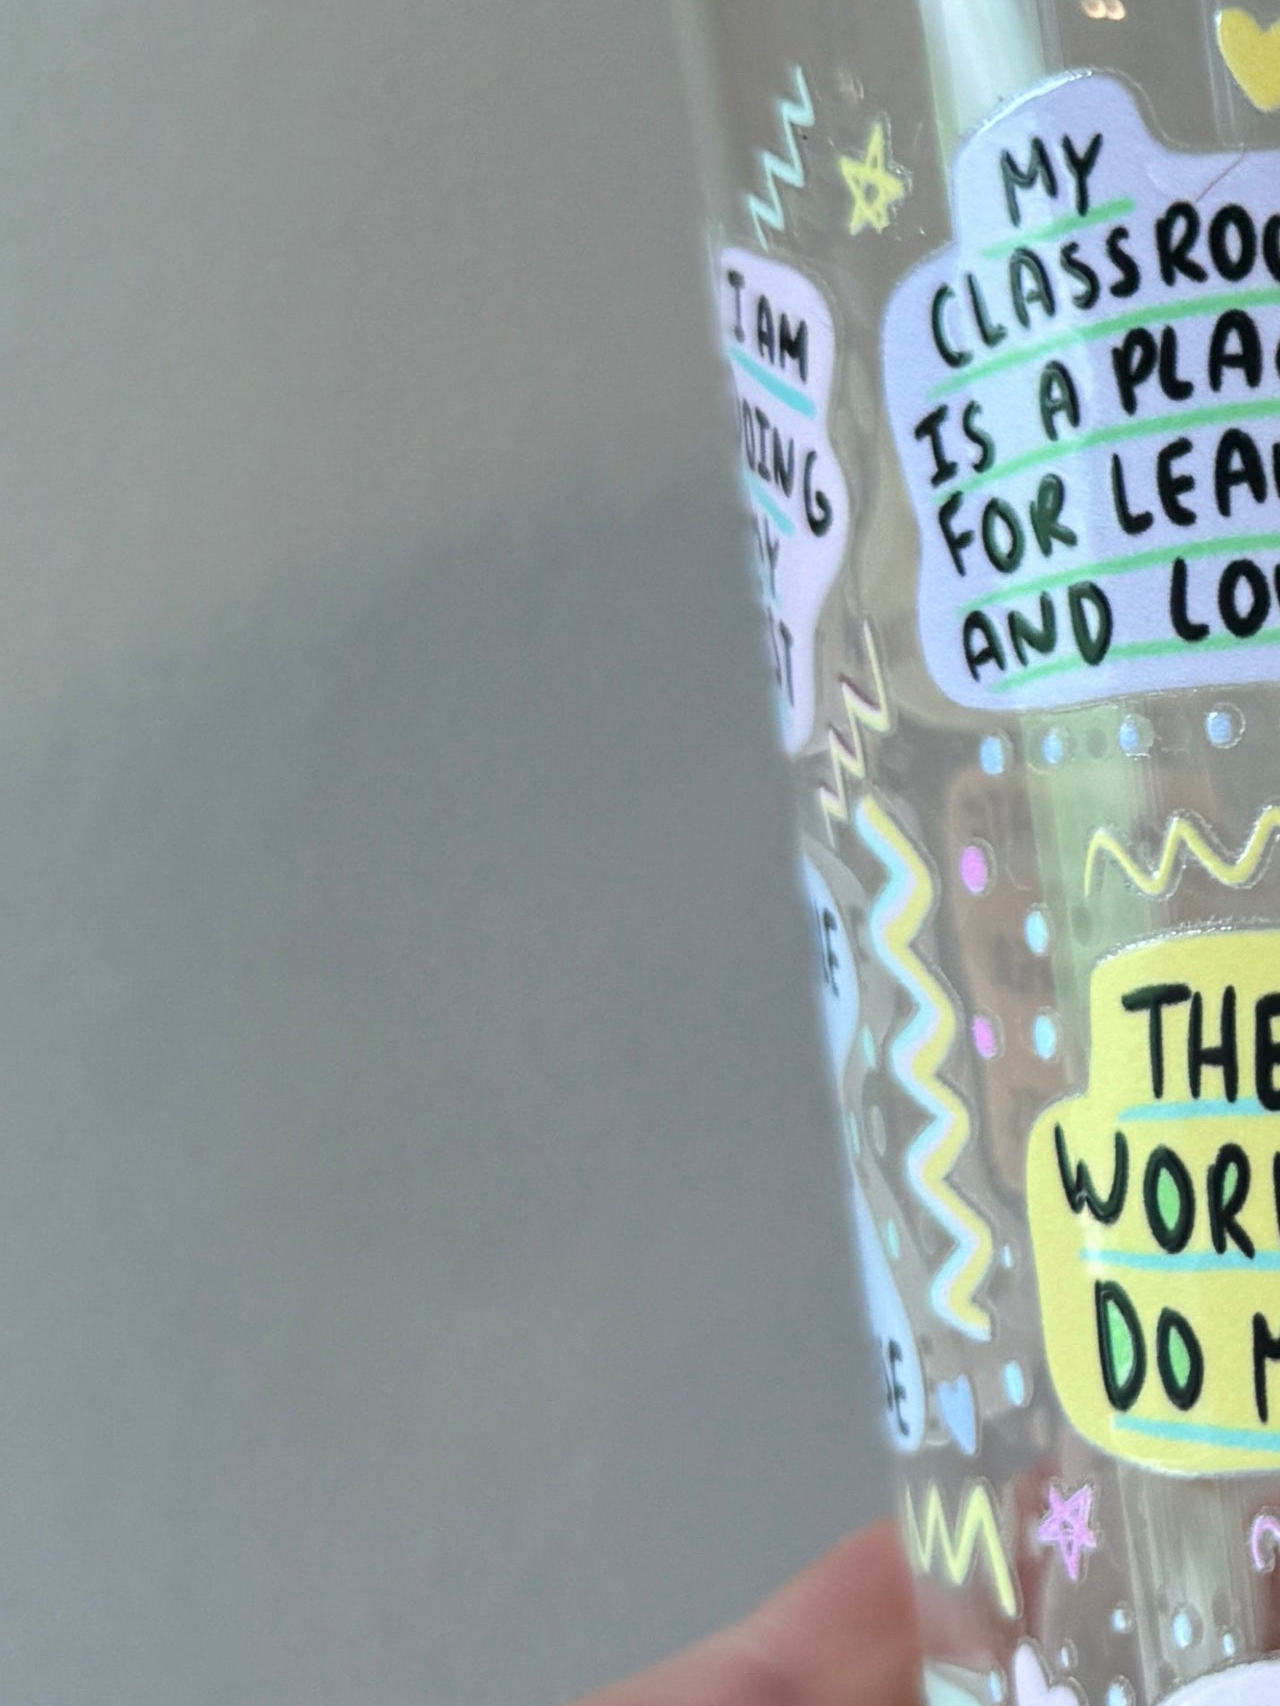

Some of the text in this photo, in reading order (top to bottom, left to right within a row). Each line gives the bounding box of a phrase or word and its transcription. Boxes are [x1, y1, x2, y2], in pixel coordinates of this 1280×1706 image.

[1000, 132, 1103, 227] MY
[727, 269, 809, 384] I AM
[912, 408, 995, 487] IS
[1040, 360, 1080, 441] A
[938, 474, 1077, 577] FOR
[962, 580, 1112, 682] AND
[1094, 1279, 1205, 1413] DO
